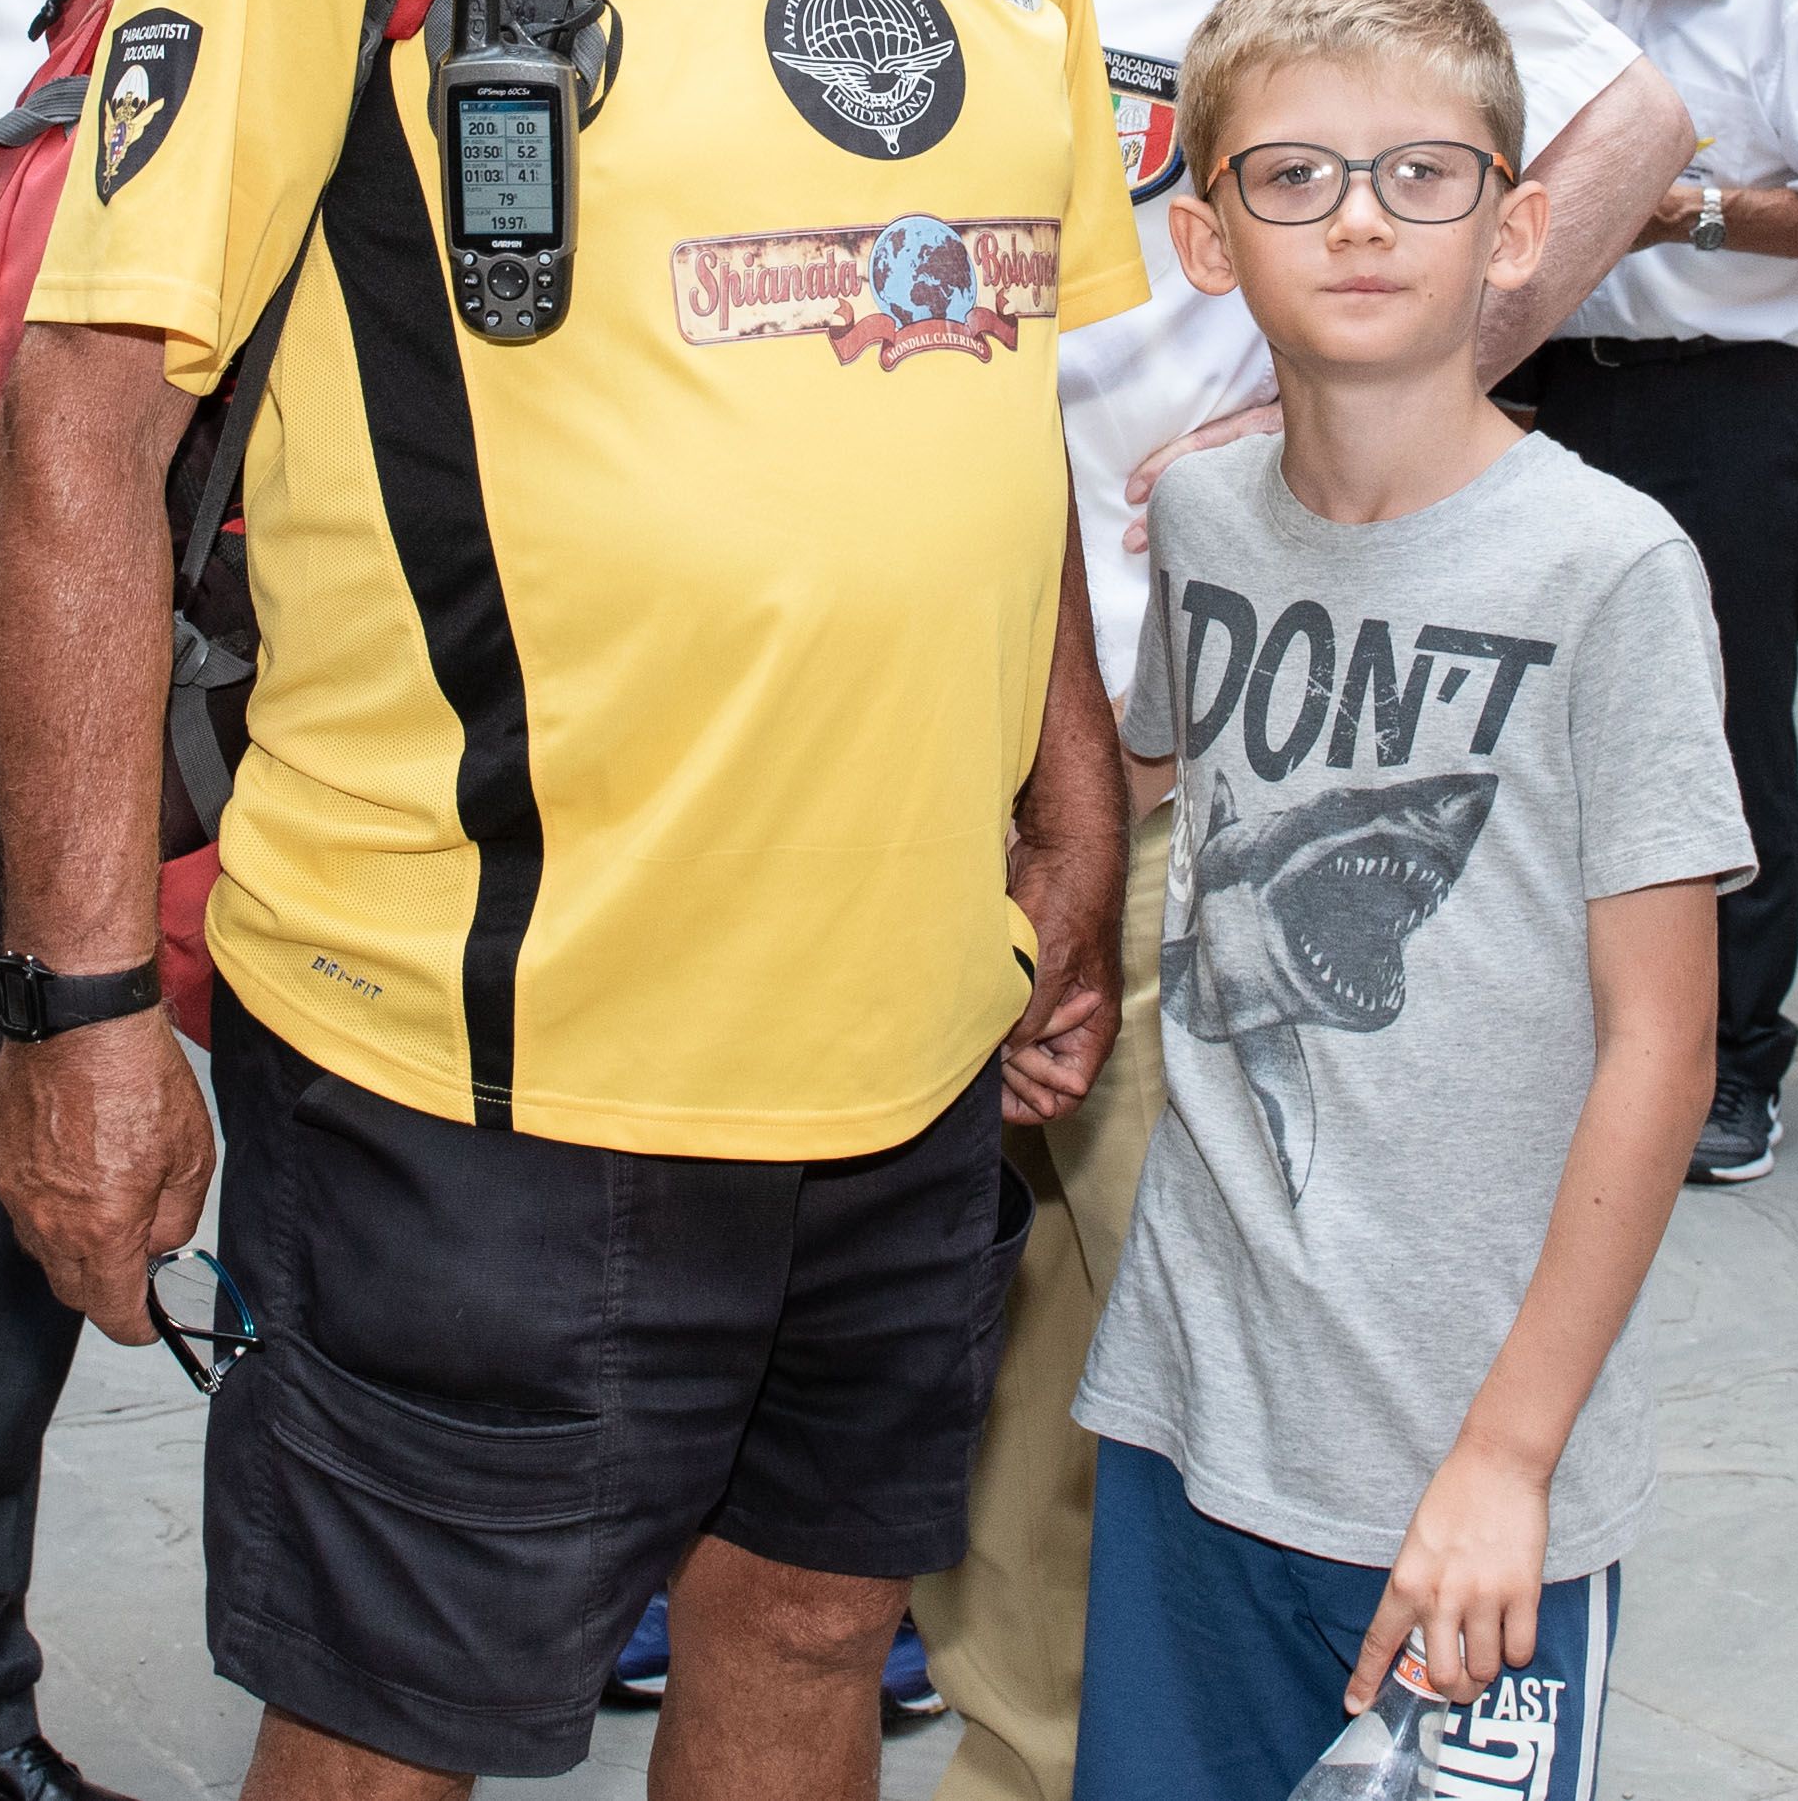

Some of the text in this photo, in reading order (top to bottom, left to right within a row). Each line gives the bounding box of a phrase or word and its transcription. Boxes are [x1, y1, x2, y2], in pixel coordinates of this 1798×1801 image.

[120, 24, 190, 44] PARACADUTISTI
[123, 44, 165, 62] BOLOGNA
[1110, 66, 1162, 91] BOLOGNA
[833, 89, 929, 125] TRIDENTINA
[491, 216, 524, 230] 19.97
[491, 240, 522, 248] GARMIN
[689, 248, 863, 332] Spianata
[886, 332, 985, 362] MONDIAL CATERING
[1180, 580, 1557, 782] DON'T
[311, 956, 383, 999] DRI-FIT
